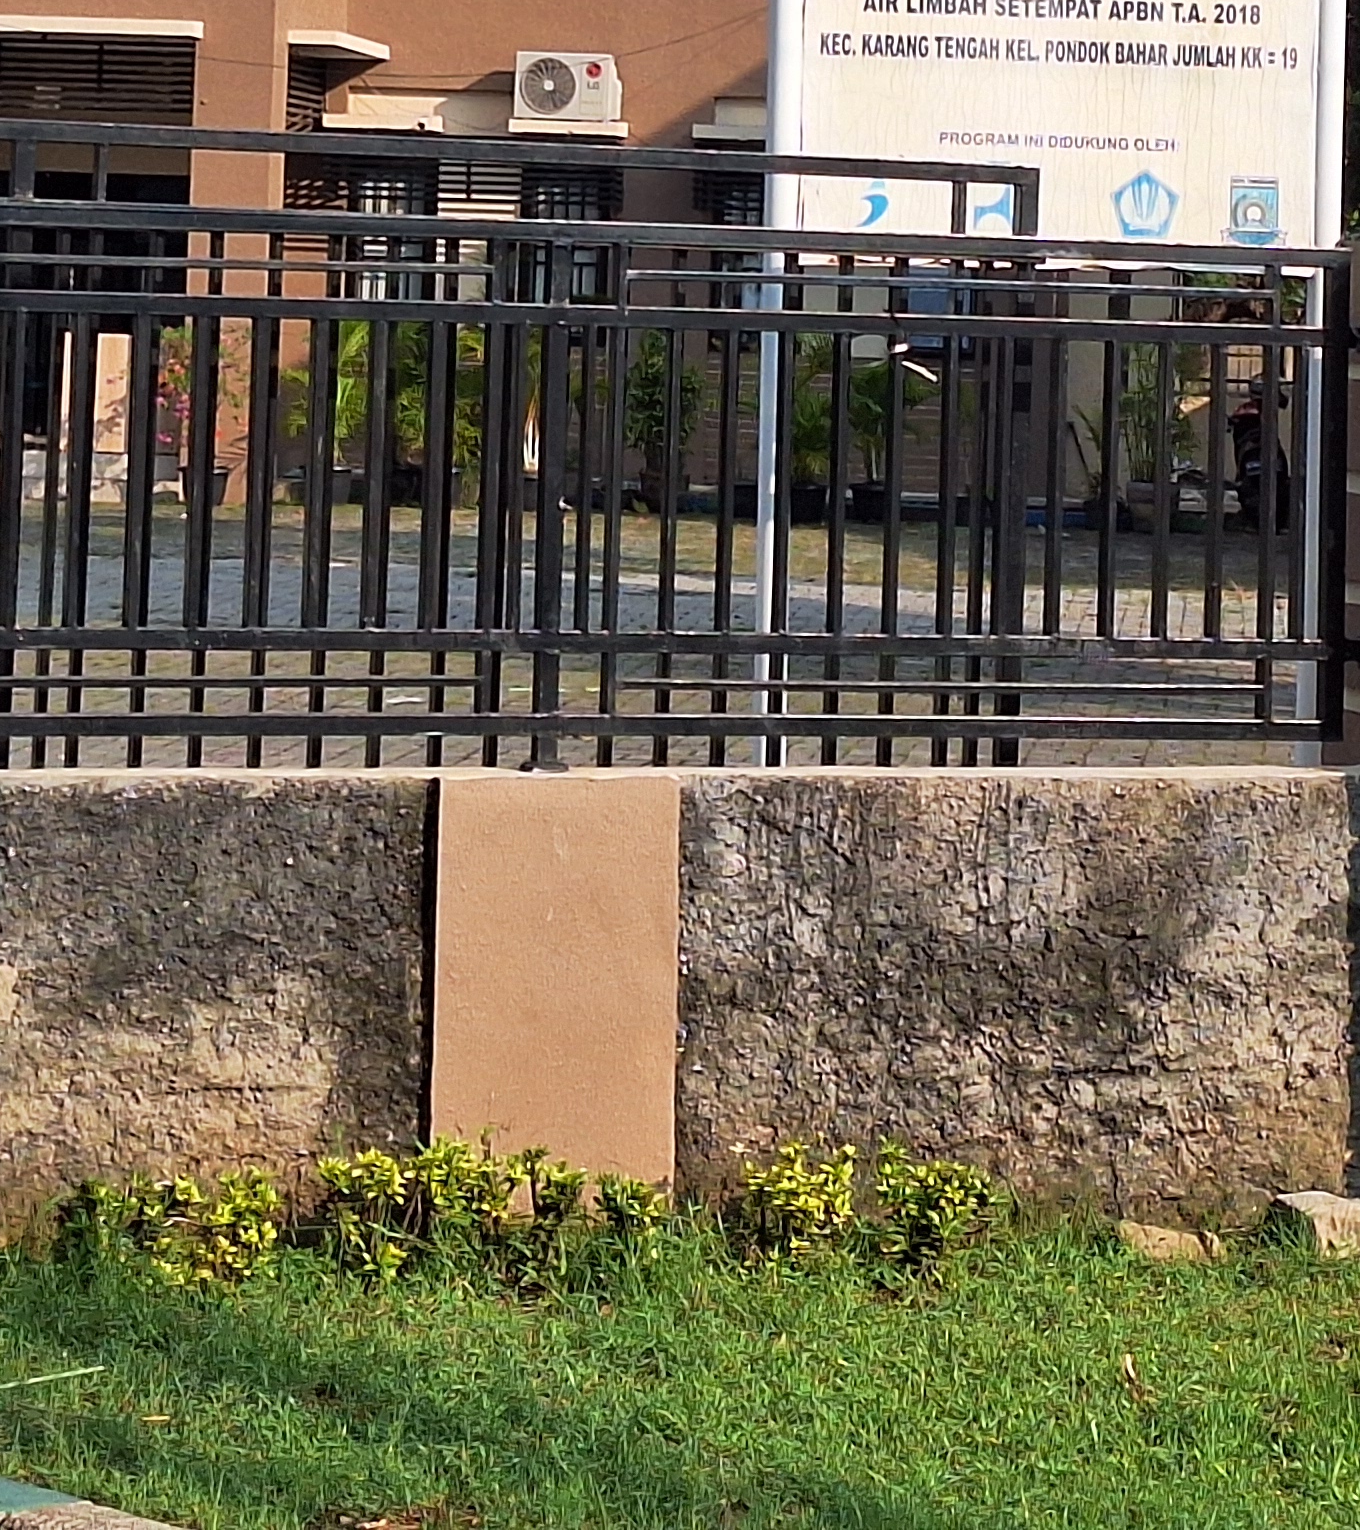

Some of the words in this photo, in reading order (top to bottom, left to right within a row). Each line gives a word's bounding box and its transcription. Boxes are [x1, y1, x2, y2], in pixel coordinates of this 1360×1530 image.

[1109, 0, 1164, 22] APBN
[1172, 2, 1207, 24] T.A.
[1213, 4, 1261, 25] 2018
[820, 33, 856, 57] KEC.
[862, 34, 929, 59] KARANG
[934, 36, 1000, 61] TENGAH
[1006, 39, 1040, 62] KEL.
[1045, 40, 1110, 65] PONDOK
[1115, 42, 1168, 67] BAHAR
[1173, 44, 1236, 69] JUMLAH
[1241, 46, 1263, 70] KK
[1267, 51, 1276, 64] =
[1282, 47, 1298, 70] 19
[939, 131, 1020, 146] PROGRAM
[1024, 134, 1043, 148] INI
[1048, 135, 1129, 151] DIDUKUNG
